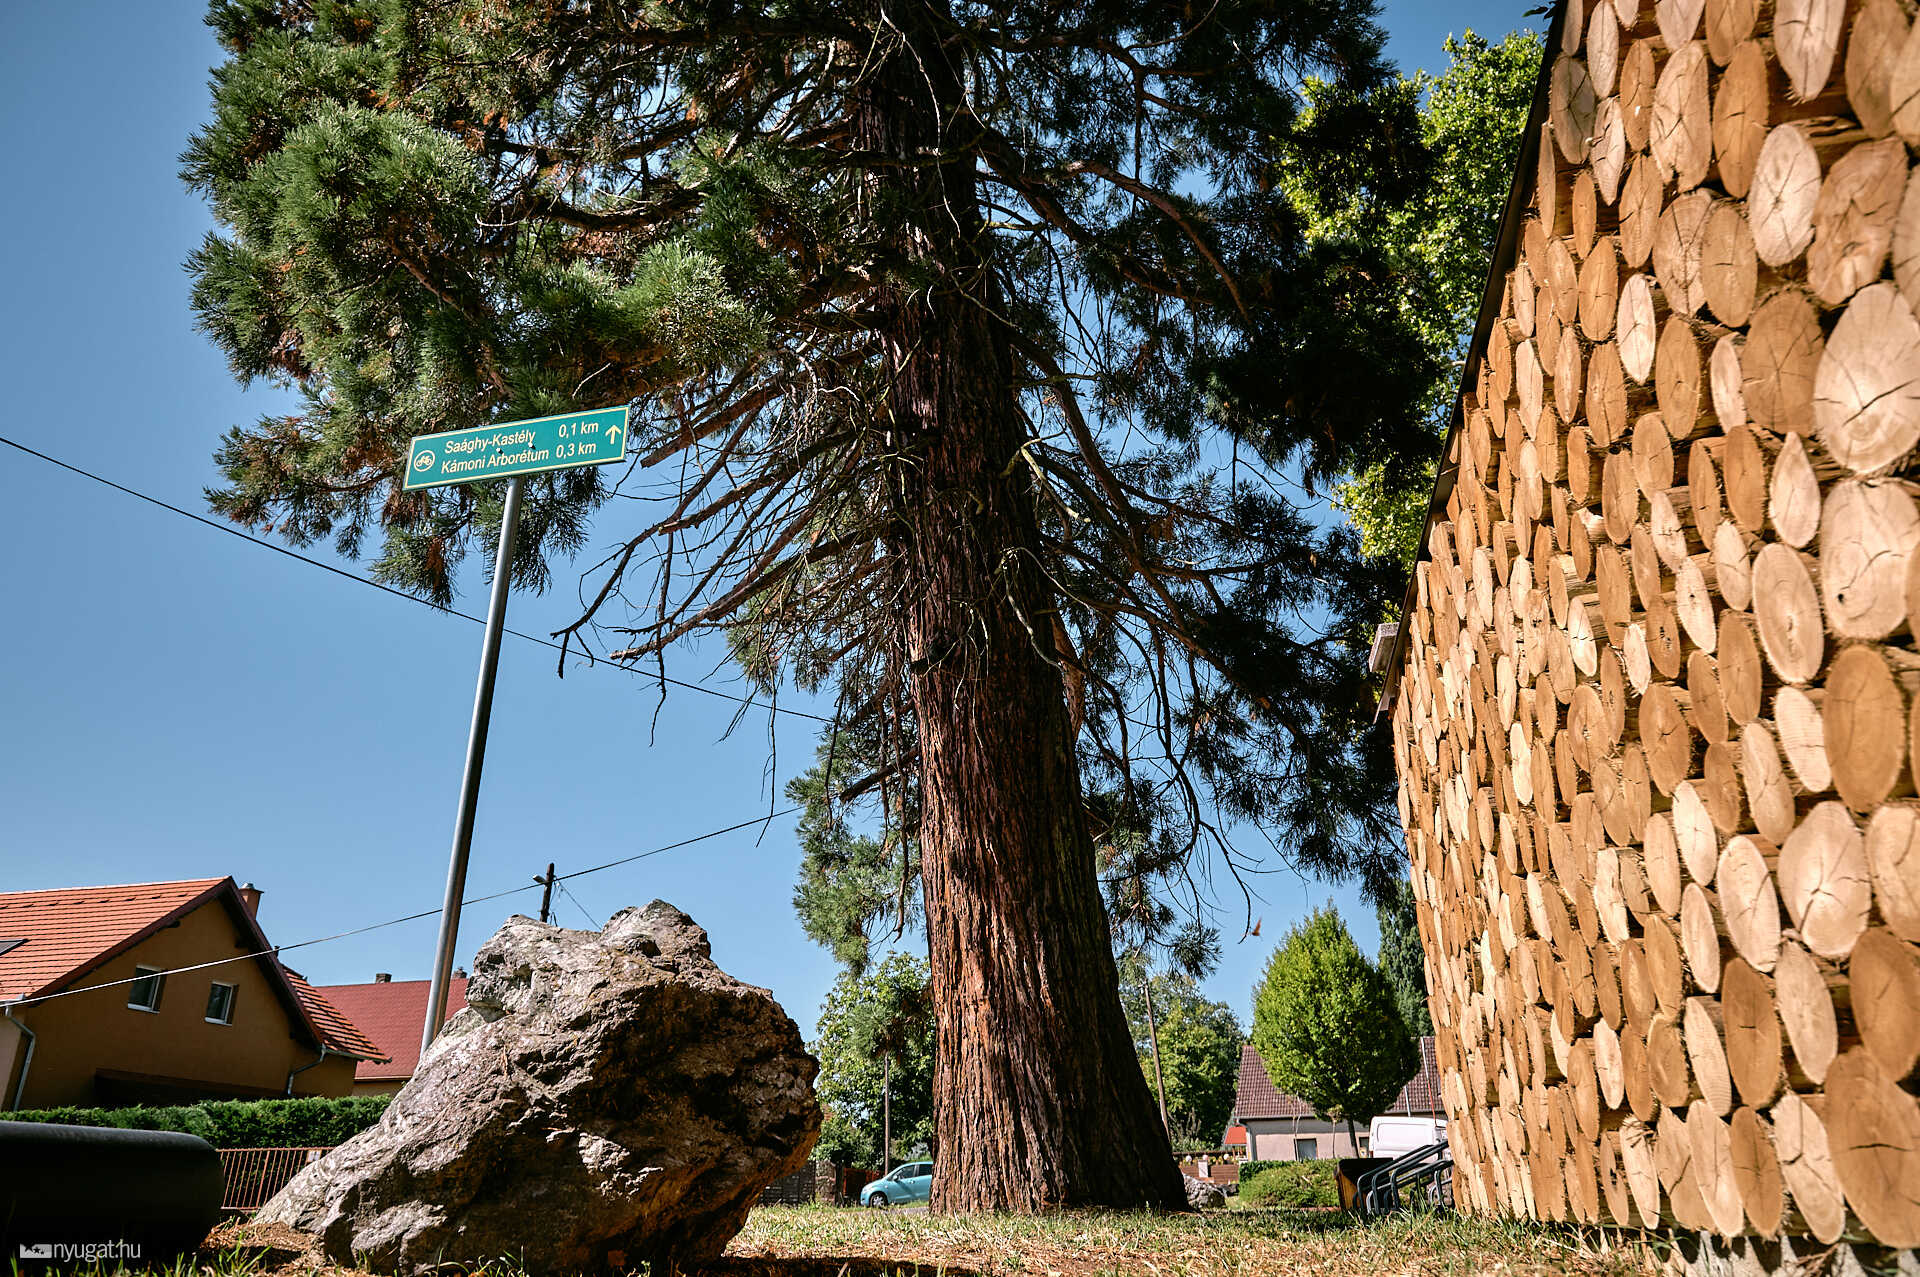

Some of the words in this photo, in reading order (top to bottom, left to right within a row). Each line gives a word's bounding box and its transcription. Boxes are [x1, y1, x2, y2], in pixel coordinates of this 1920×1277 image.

[444, 430, 536, 455] Saághy-Kastély
[558, 423, 577, 439] 0,1
[580, 420, 599, 435] km
[440, 457, 486, 474] Kámoni
[488, 448, 549, 467] Arborétum
[555, 444, 575, 460] 0,3
[578, 441, 596, 455] km
